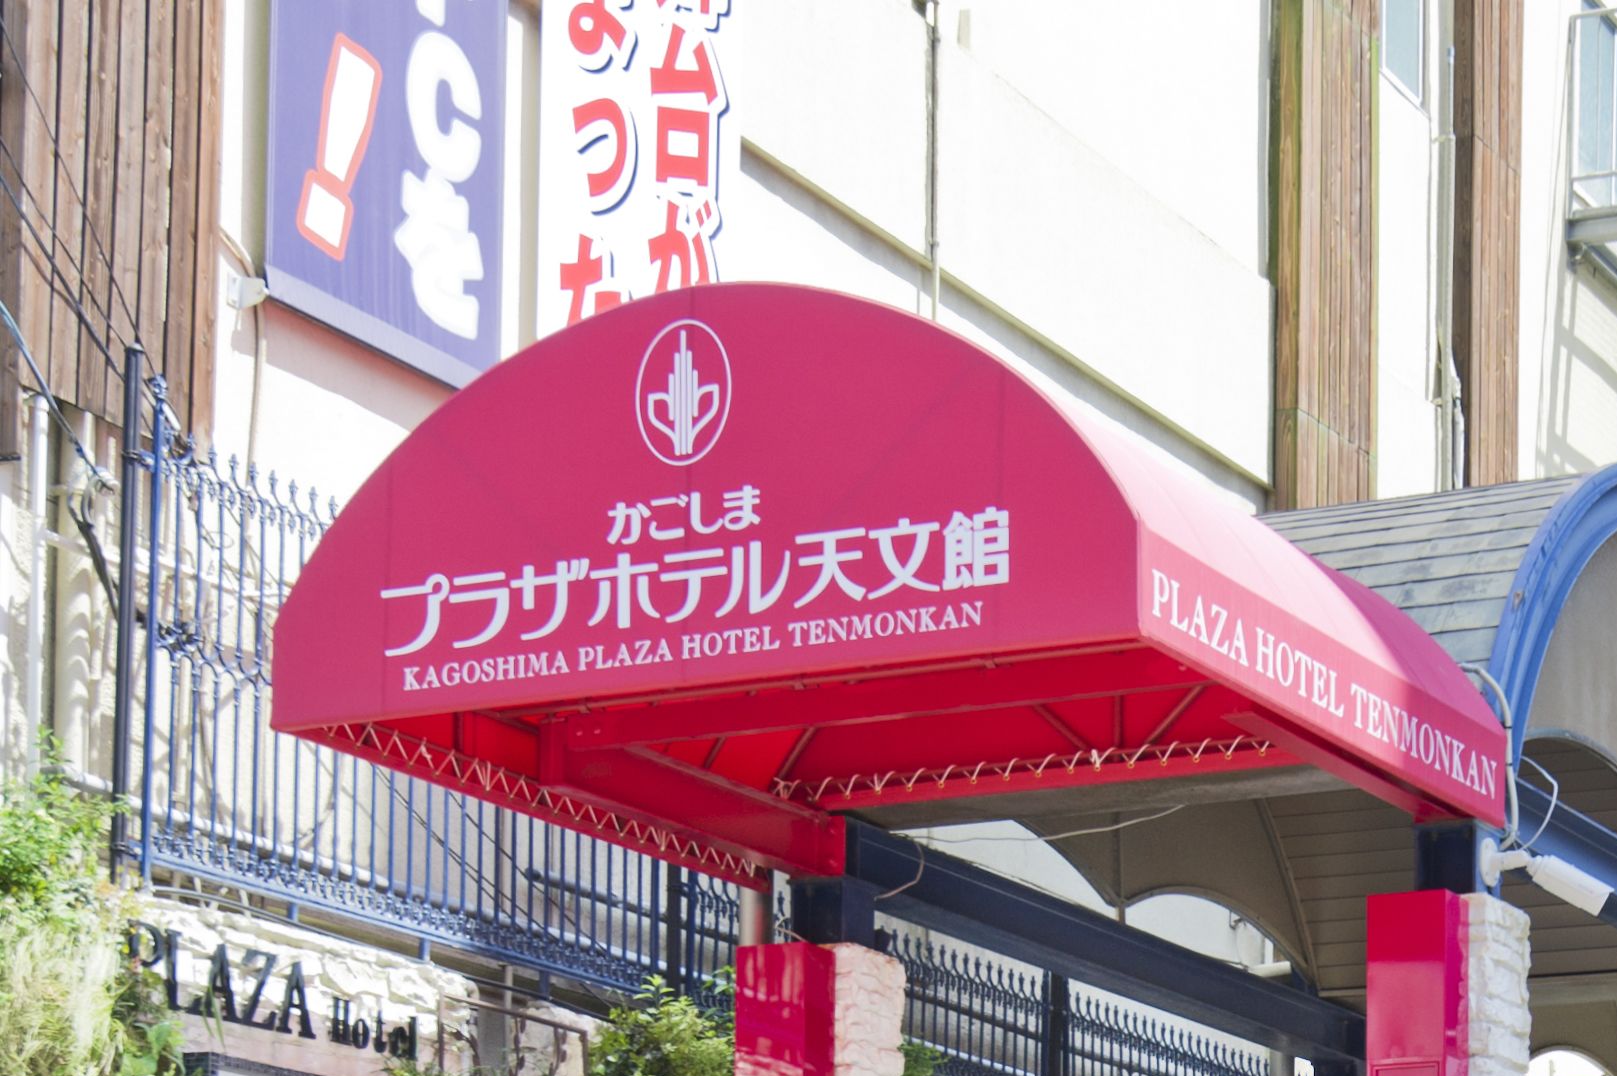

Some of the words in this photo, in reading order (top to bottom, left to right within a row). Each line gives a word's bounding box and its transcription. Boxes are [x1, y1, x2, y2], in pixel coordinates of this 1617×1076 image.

[606, 484, 761, 546] かごしま
[379, 506, 1011, 658] プラザホテル天文館
[402, 645, 571, 692] KAGOSHIMA
[576, 634, 674, 672] PLAZA
[681, 624, 781, 661] HOTEL
[788, 601, 984, 648] TENMONKAN
[1151, 568, 1249, 669] PLAZA
[1255, 626, 1345, 718] HOTEL
[1350, 682, 1498, 800] TENMONKAN
[127, 918, 317, 1040] PLAZA
